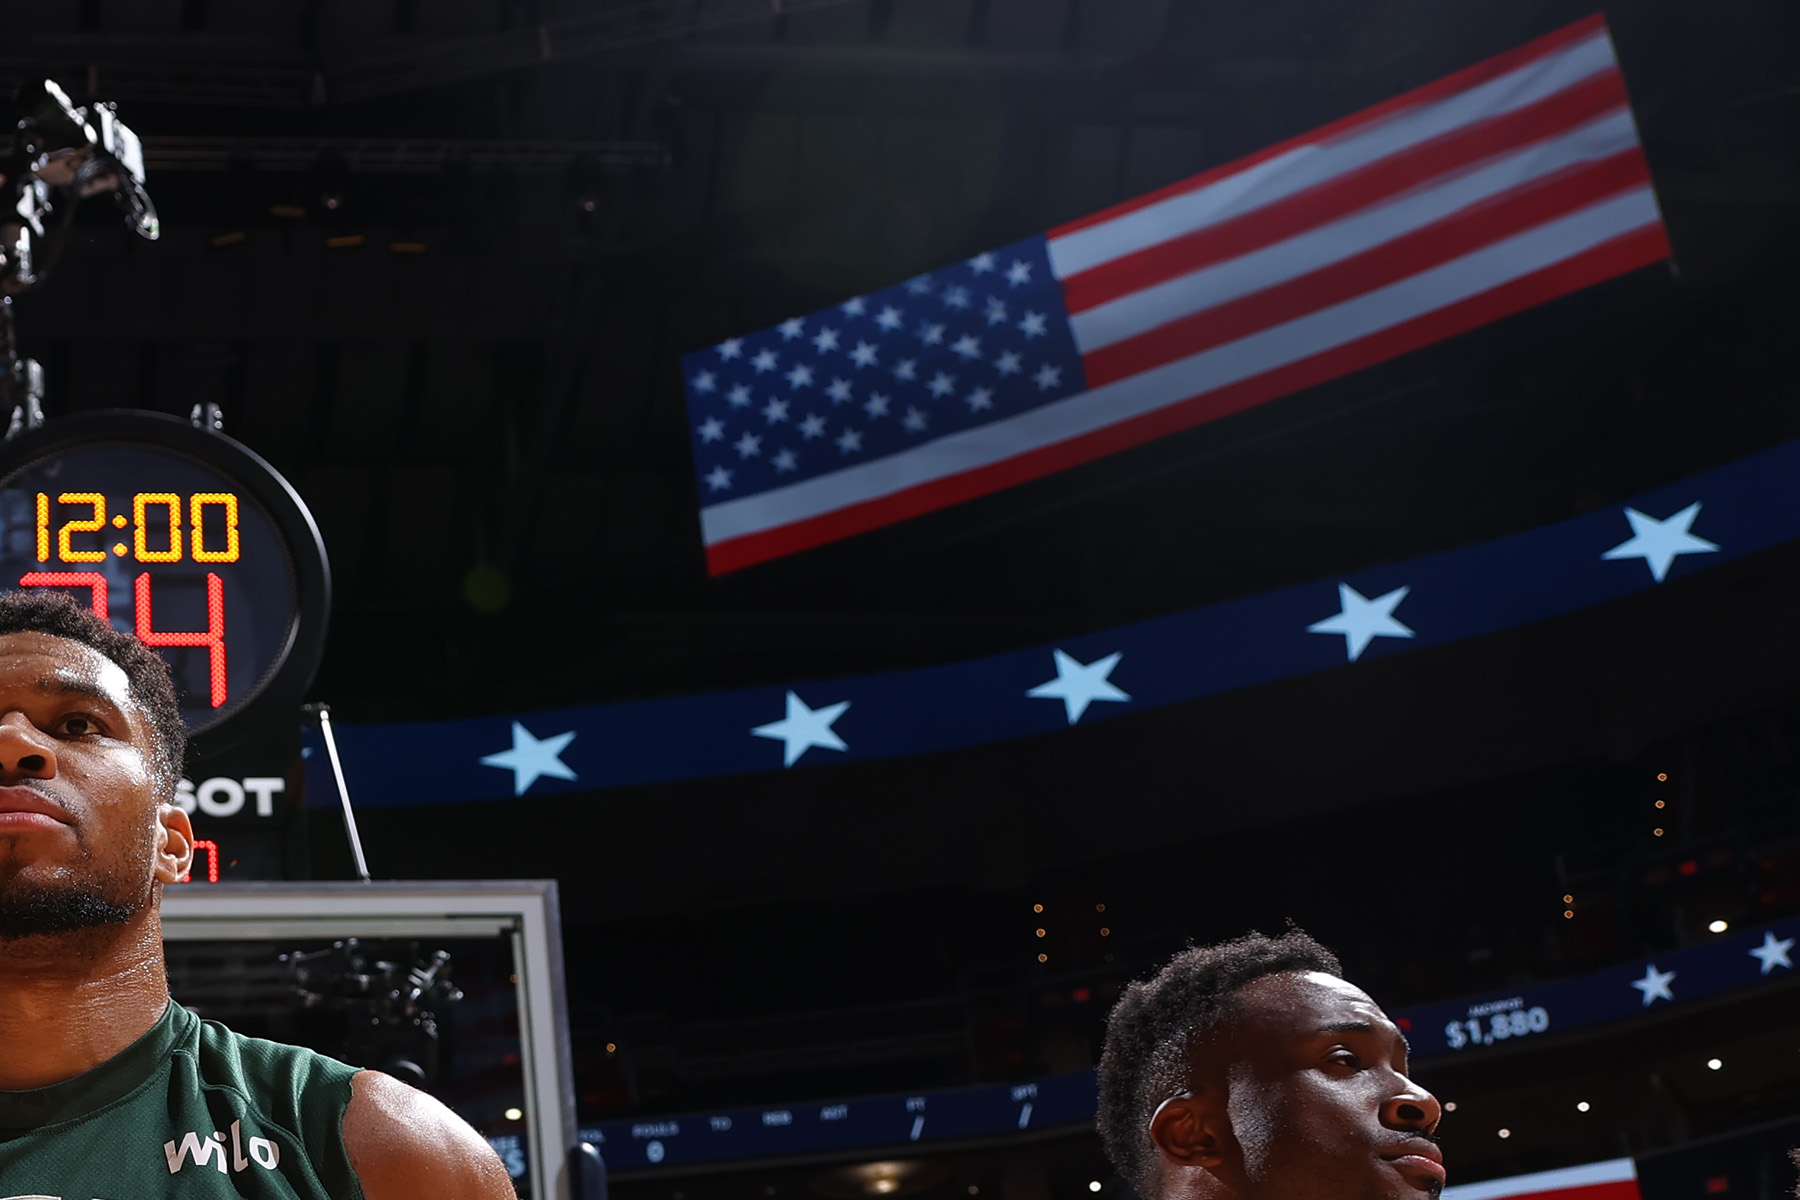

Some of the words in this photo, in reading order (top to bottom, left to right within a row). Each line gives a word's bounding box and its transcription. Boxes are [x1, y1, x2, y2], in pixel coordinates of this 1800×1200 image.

[36, 492, 240, 563] 12:00
[174, 777, 285, 817] SOT
[164, 1119, 280, 1174] wilo
